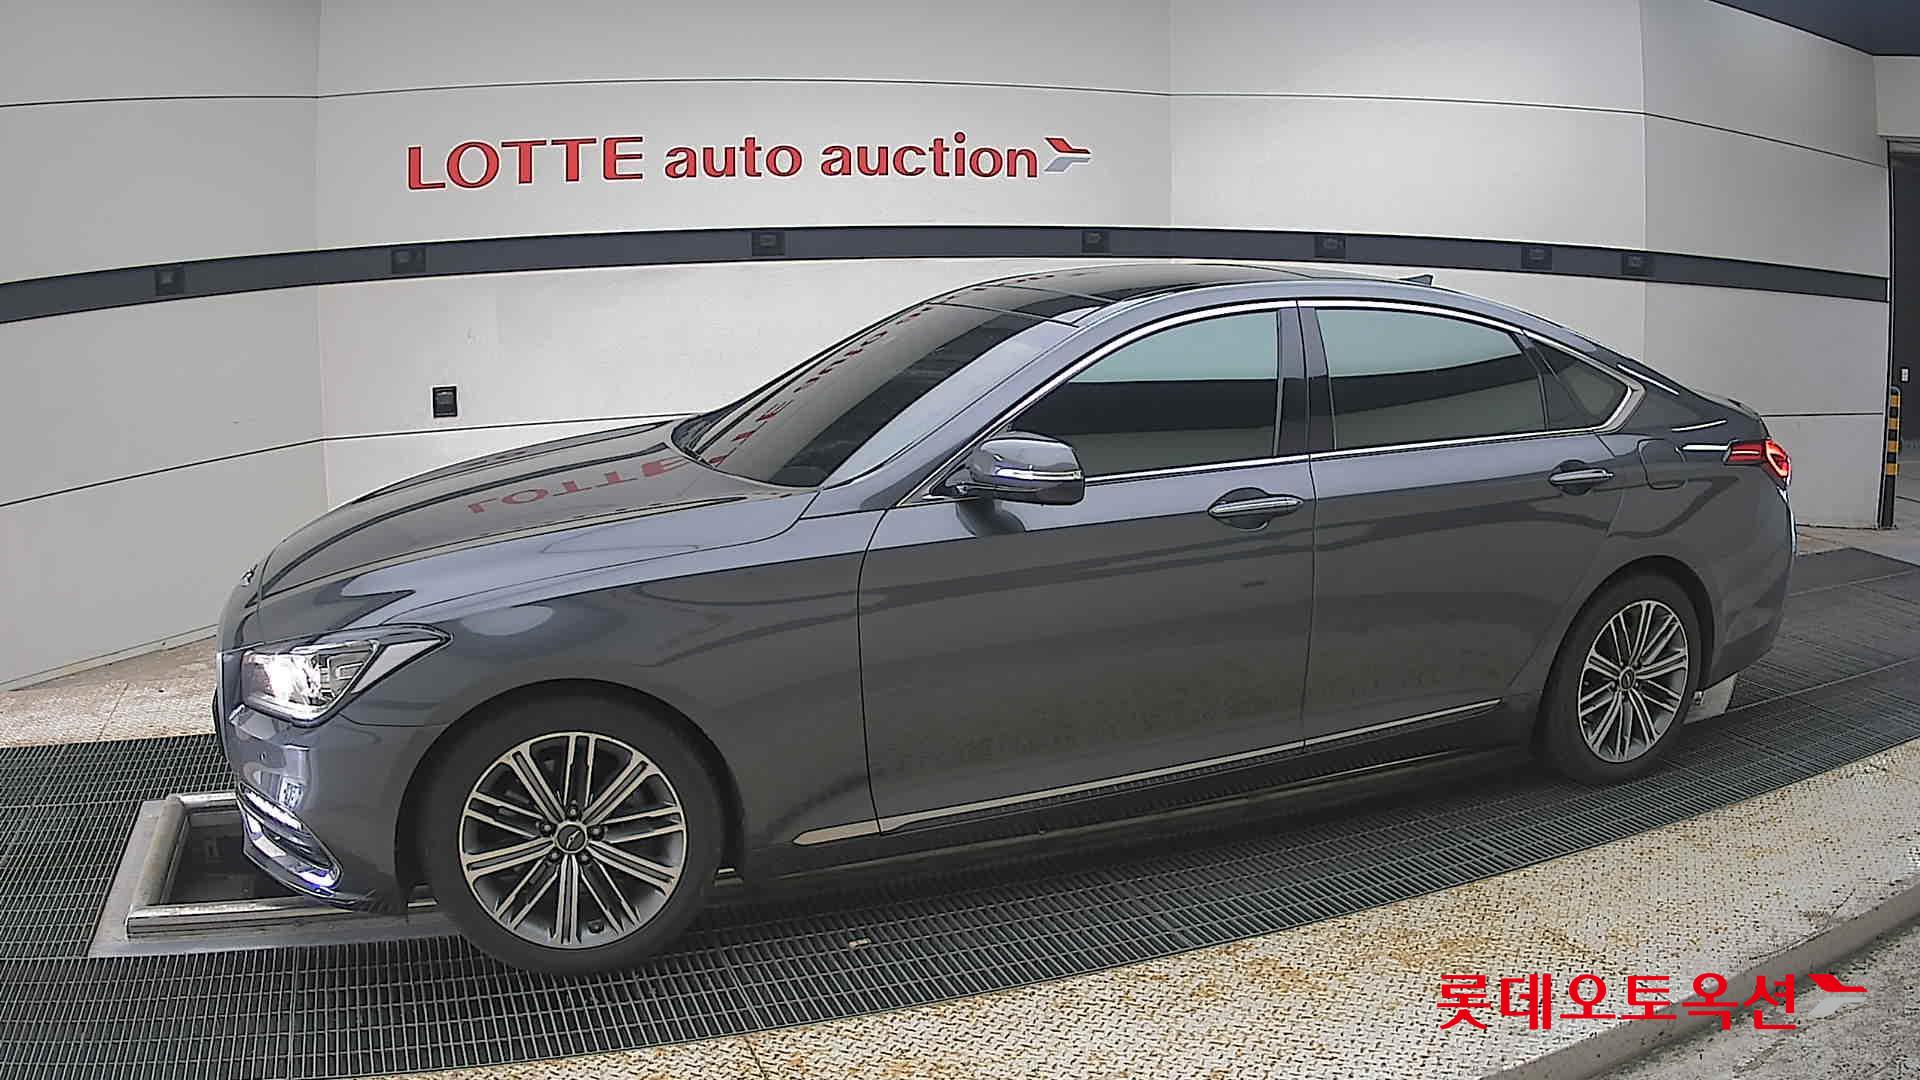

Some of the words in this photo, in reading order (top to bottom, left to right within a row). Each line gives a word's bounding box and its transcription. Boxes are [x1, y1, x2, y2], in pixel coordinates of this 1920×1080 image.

[406, 135, 645, 191] LOTTE
[664, 136, 803, 179] auto
[820, 132, 1039, 178] auction
